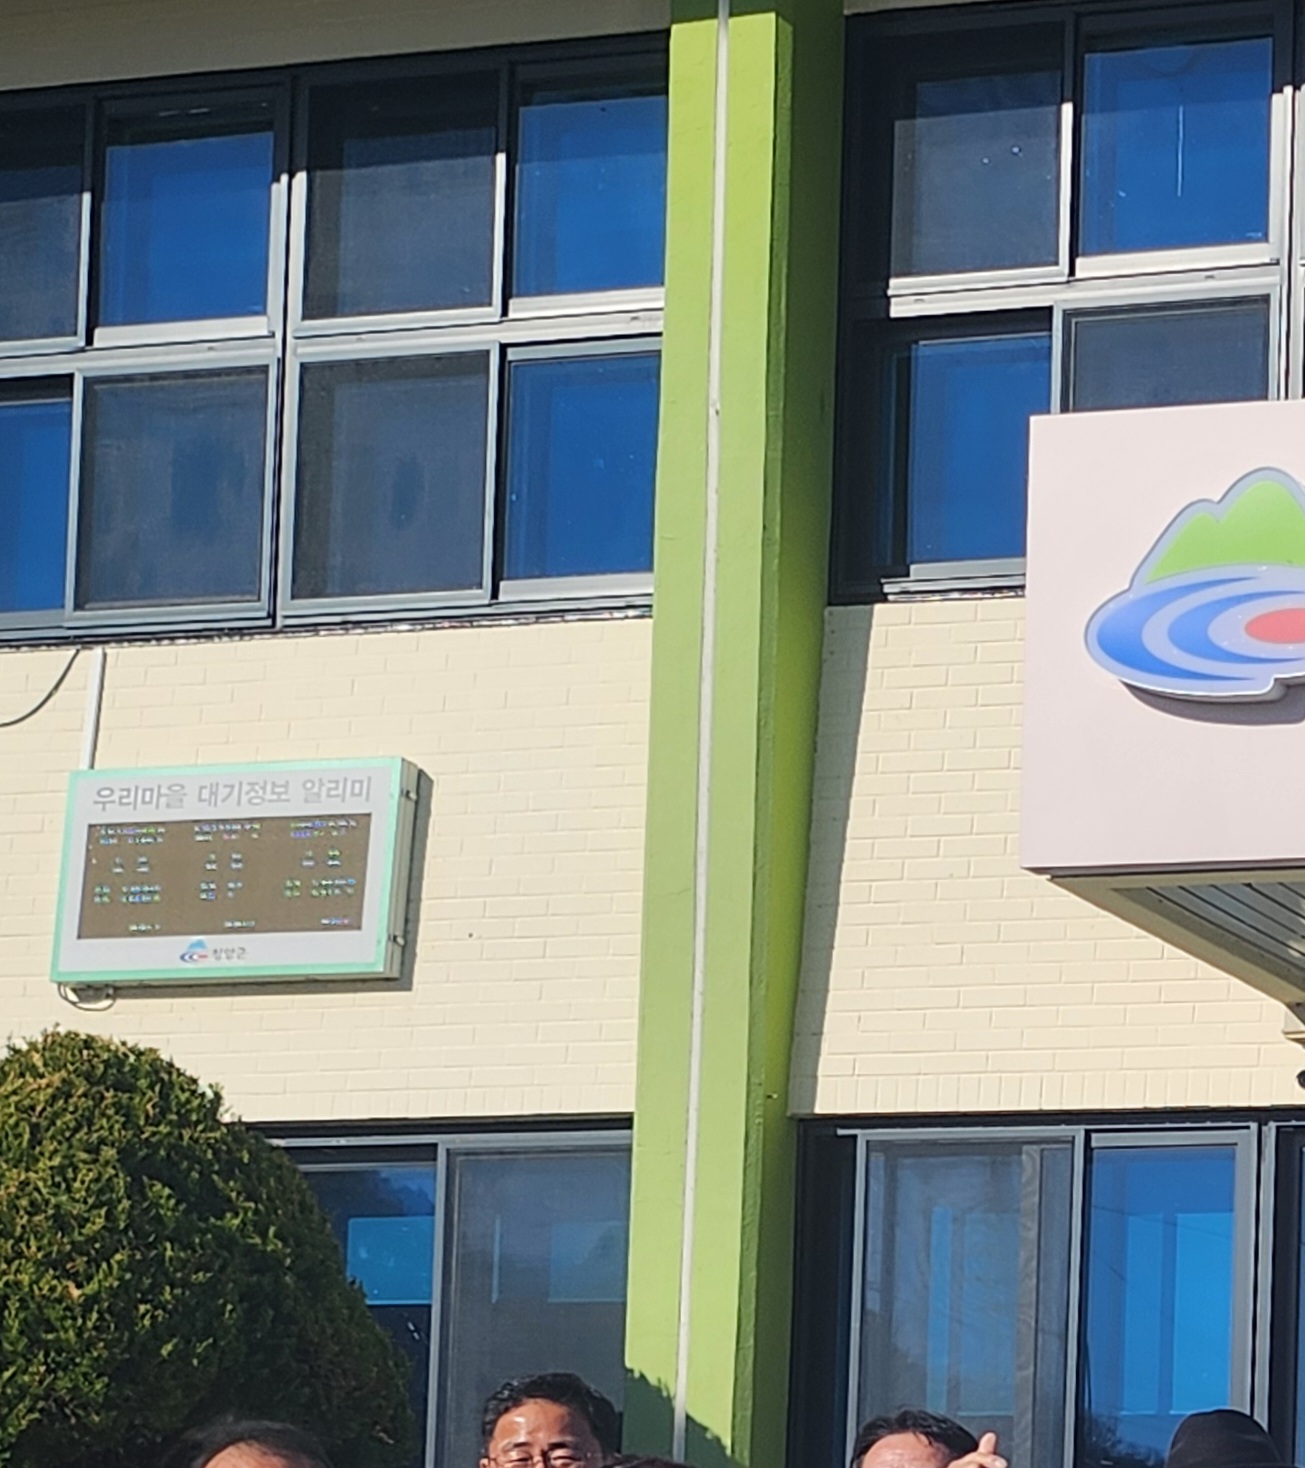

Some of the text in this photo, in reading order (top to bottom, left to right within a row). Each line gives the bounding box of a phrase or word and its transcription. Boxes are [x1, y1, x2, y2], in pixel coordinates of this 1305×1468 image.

[93, 776, 373, 811] 우리마을 대기정보 알리미
